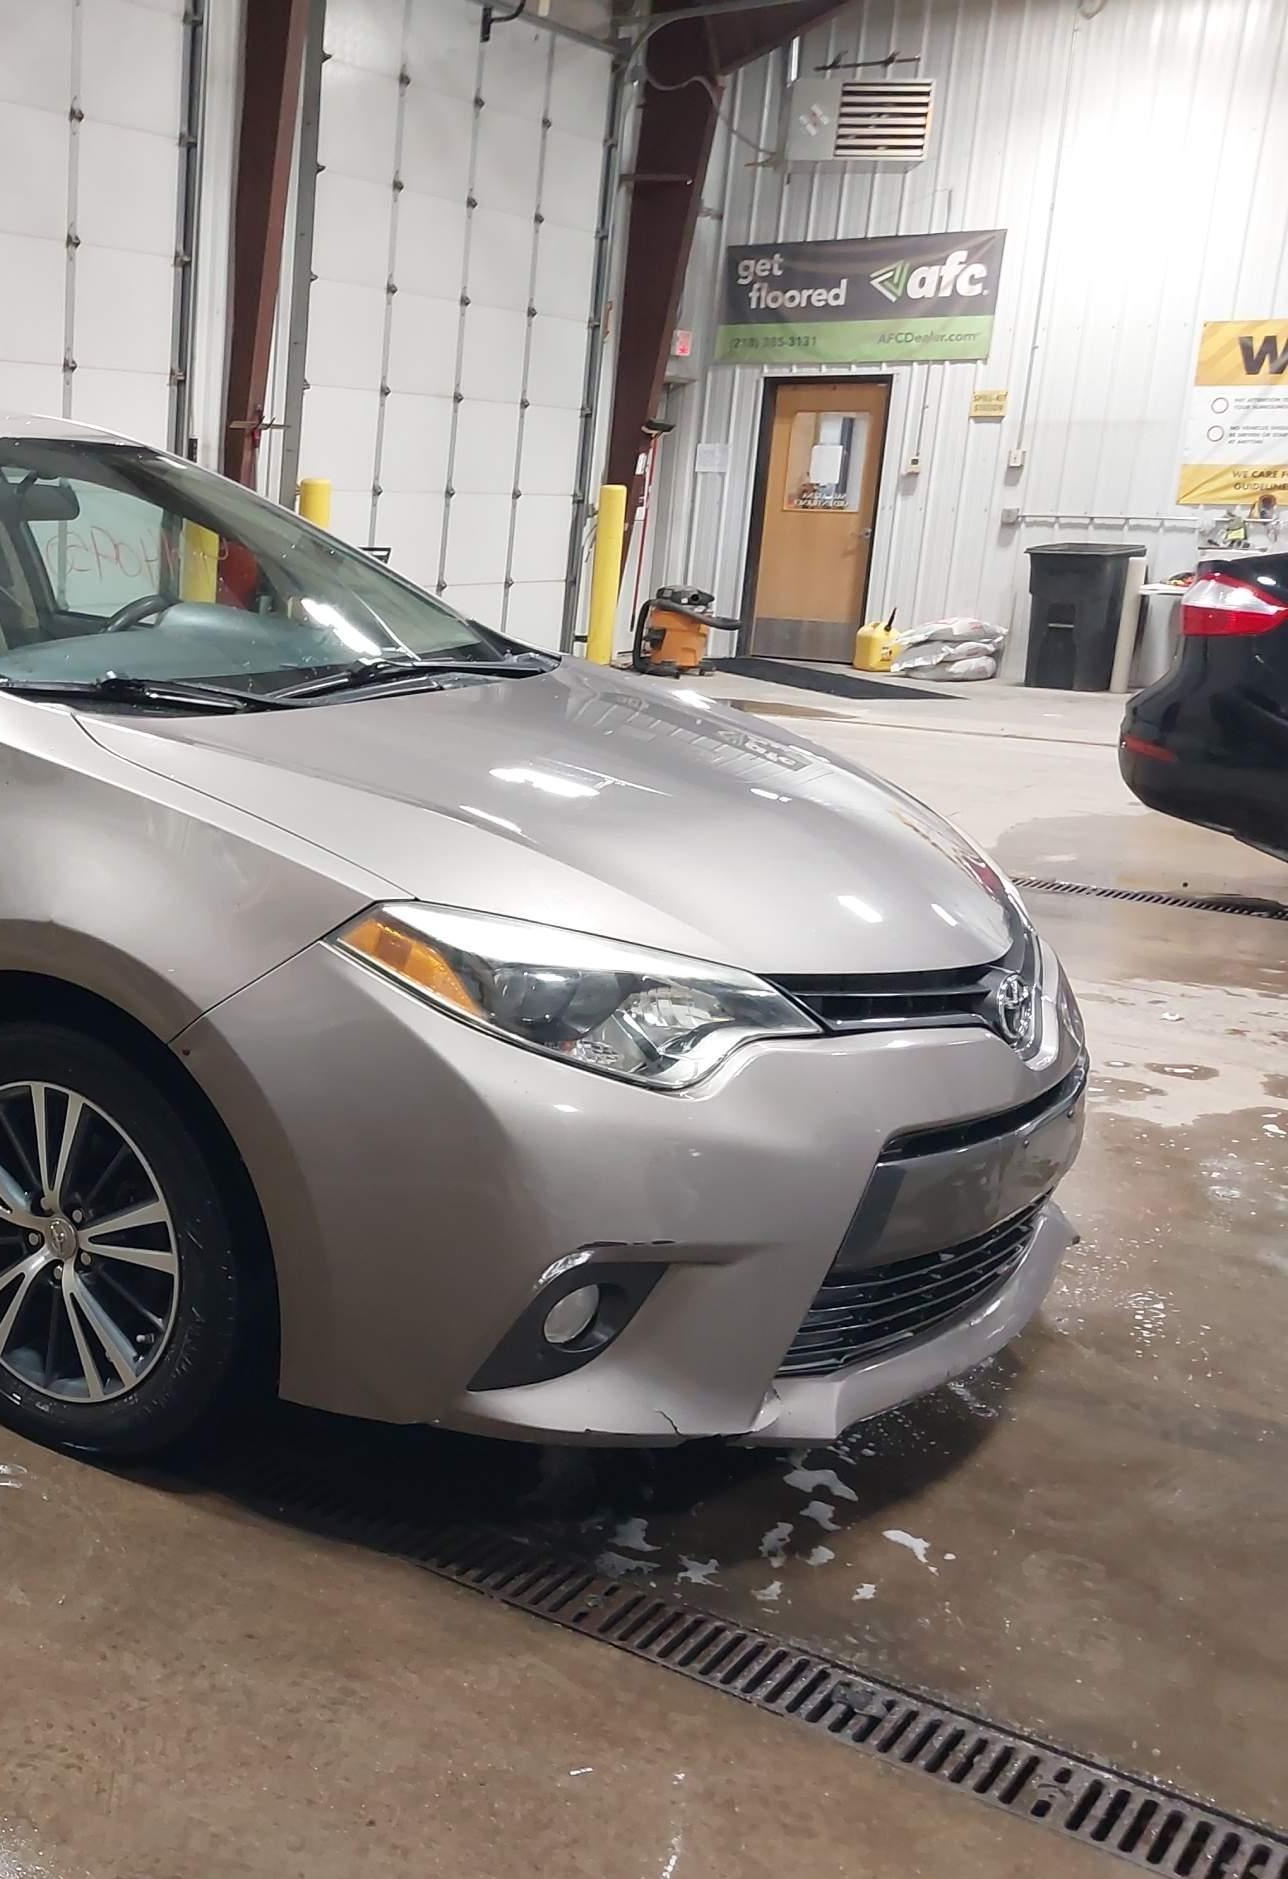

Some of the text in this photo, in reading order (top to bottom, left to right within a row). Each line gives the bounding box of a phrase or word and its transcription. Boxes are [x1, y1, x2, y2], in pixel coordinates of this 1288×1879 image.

[737, 252, 784, 285] get
[906, 250, 986, 299] afc
[748, 279, 848, 310] floored
[1232, 470, 1248, 479] WE
[1251, 470, 1279, 479] CARE
